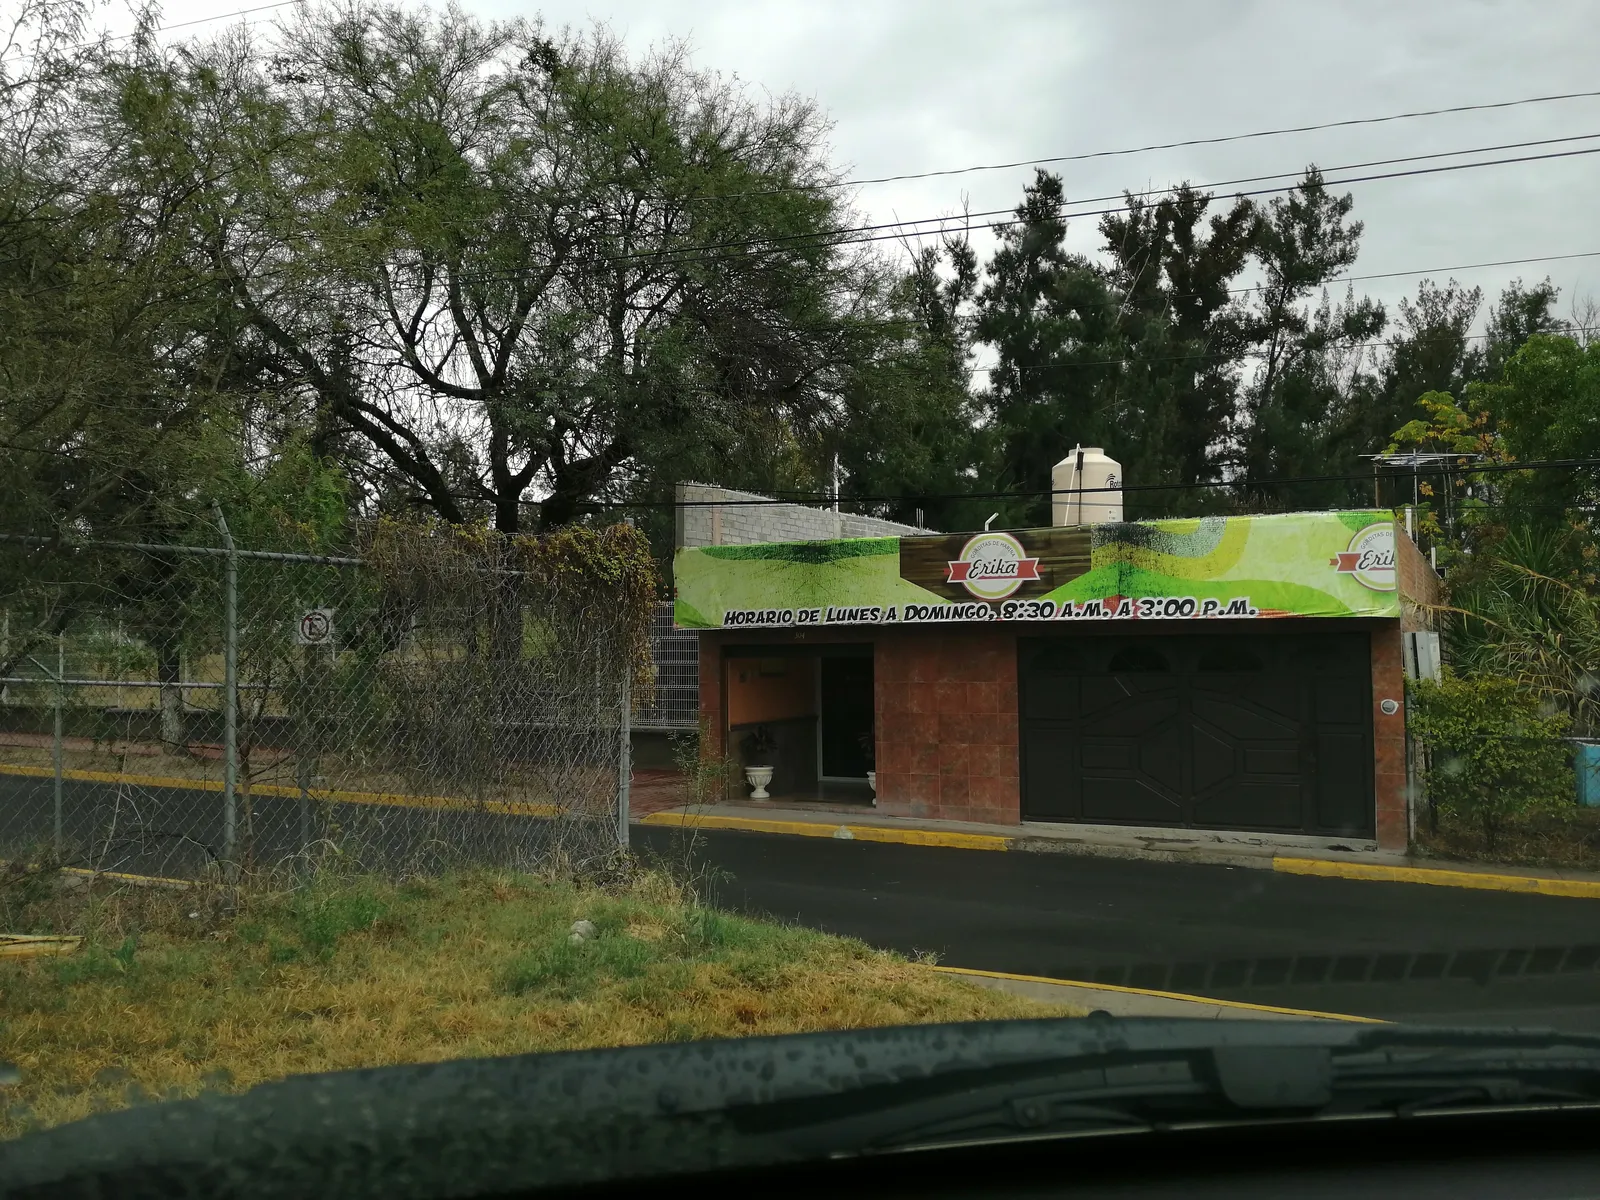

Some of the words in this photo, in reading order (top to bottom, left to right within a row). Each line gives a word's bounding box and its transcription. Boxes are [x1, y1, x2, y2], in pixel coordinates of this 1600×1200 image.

[970, 541, 992, 559] GORDITAS
[1360, 531, 1385, 550] GORDITAS
[968, 558, 1016, 579] Erika
[724, 609, 793, 625] HORARIO
[797, 609, 820, 622] DE
[826, 607, 880, 621] LUNES
[885, 606, 897, 620] A
[904, 604, 994, 620] DOMINGO,
[1003, 602, 1055, 619] 8:30
[1060, 602, 1109, 618] A.M.
[1118, 602, 1131, 616] A
[1139, 599, 1196, 617] 3:00
[1202, 599, 1256, 616] P.M.
